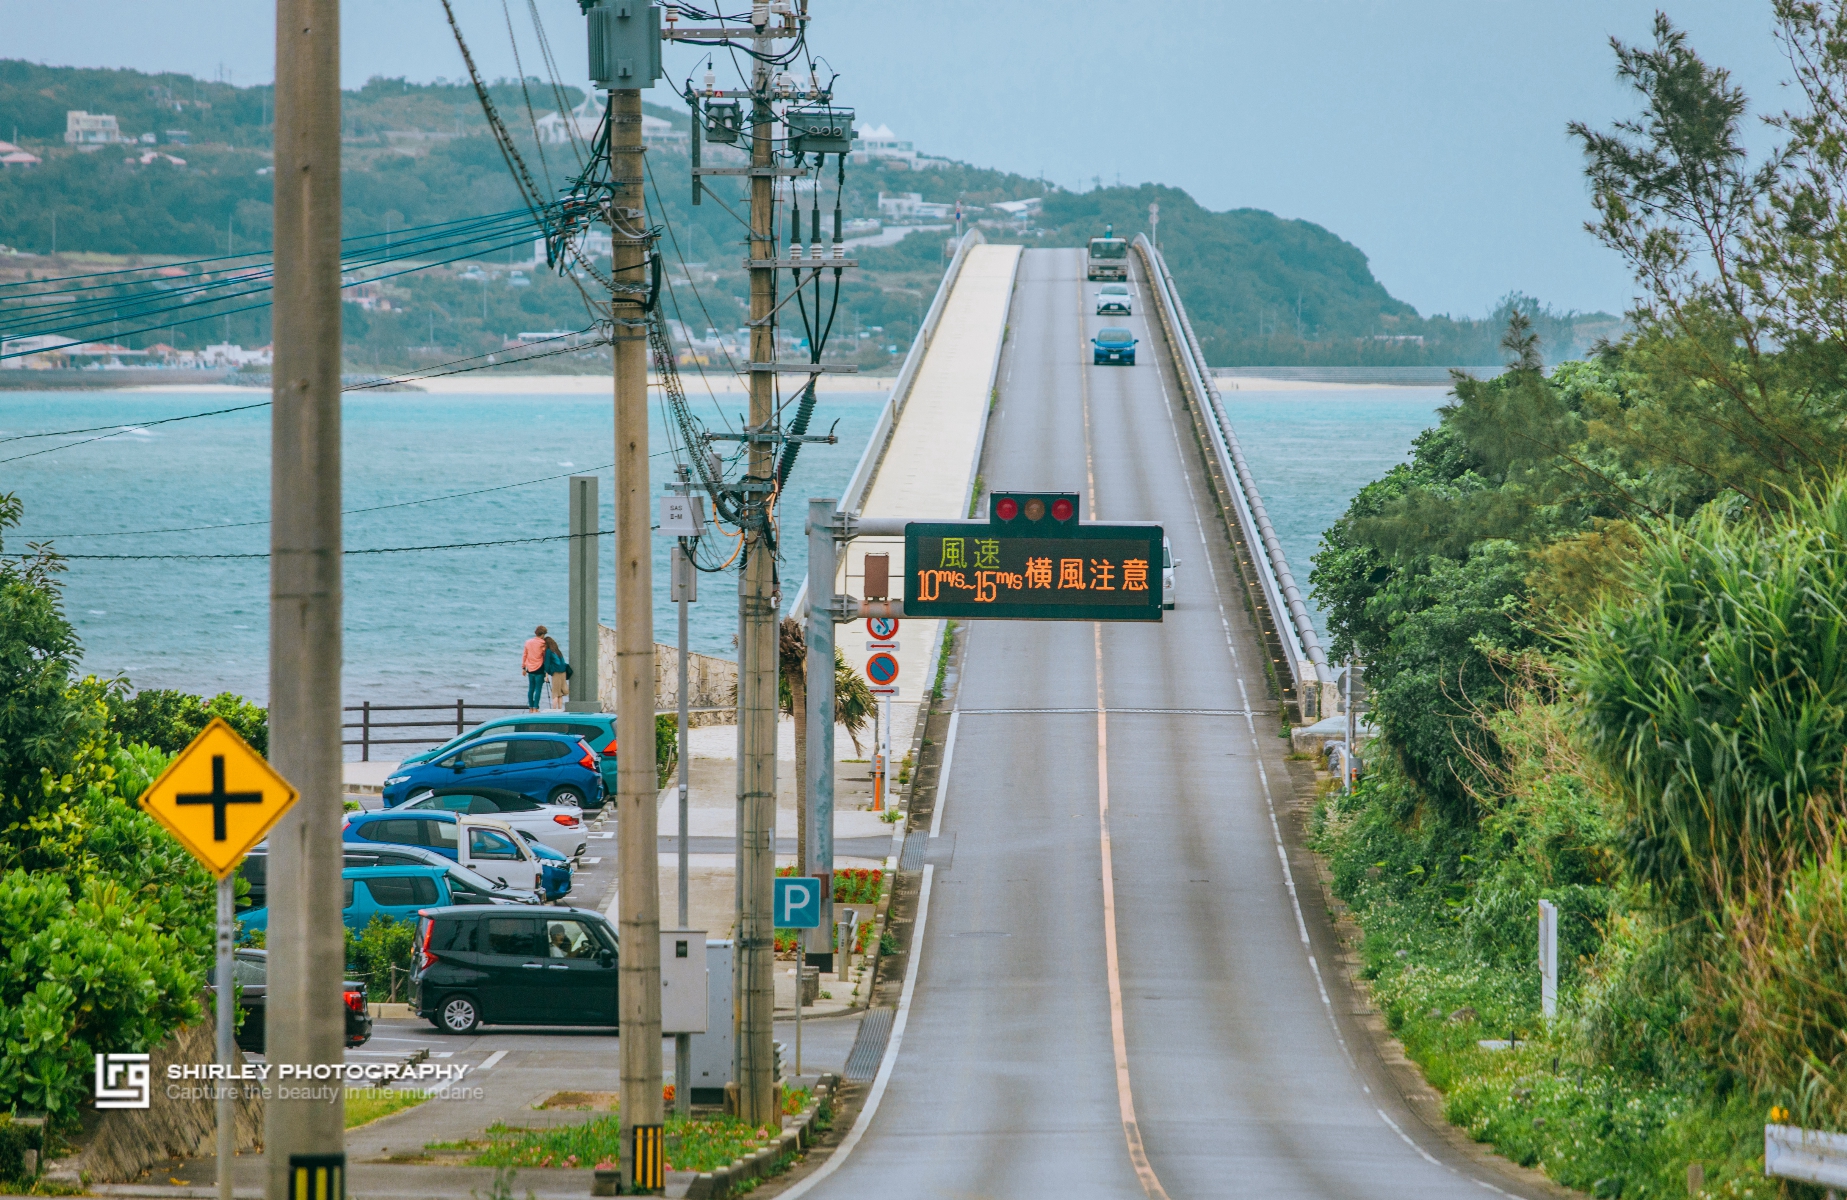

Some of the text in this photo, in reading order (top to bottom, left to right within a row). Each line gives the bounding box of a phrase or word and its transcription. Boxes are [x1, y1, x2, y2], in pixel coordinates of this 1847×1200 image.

[939, 537, 1000, 569] 風速
[1025, 557, 1149, 591] 横風注意
[785, 885, 811, 922] P
